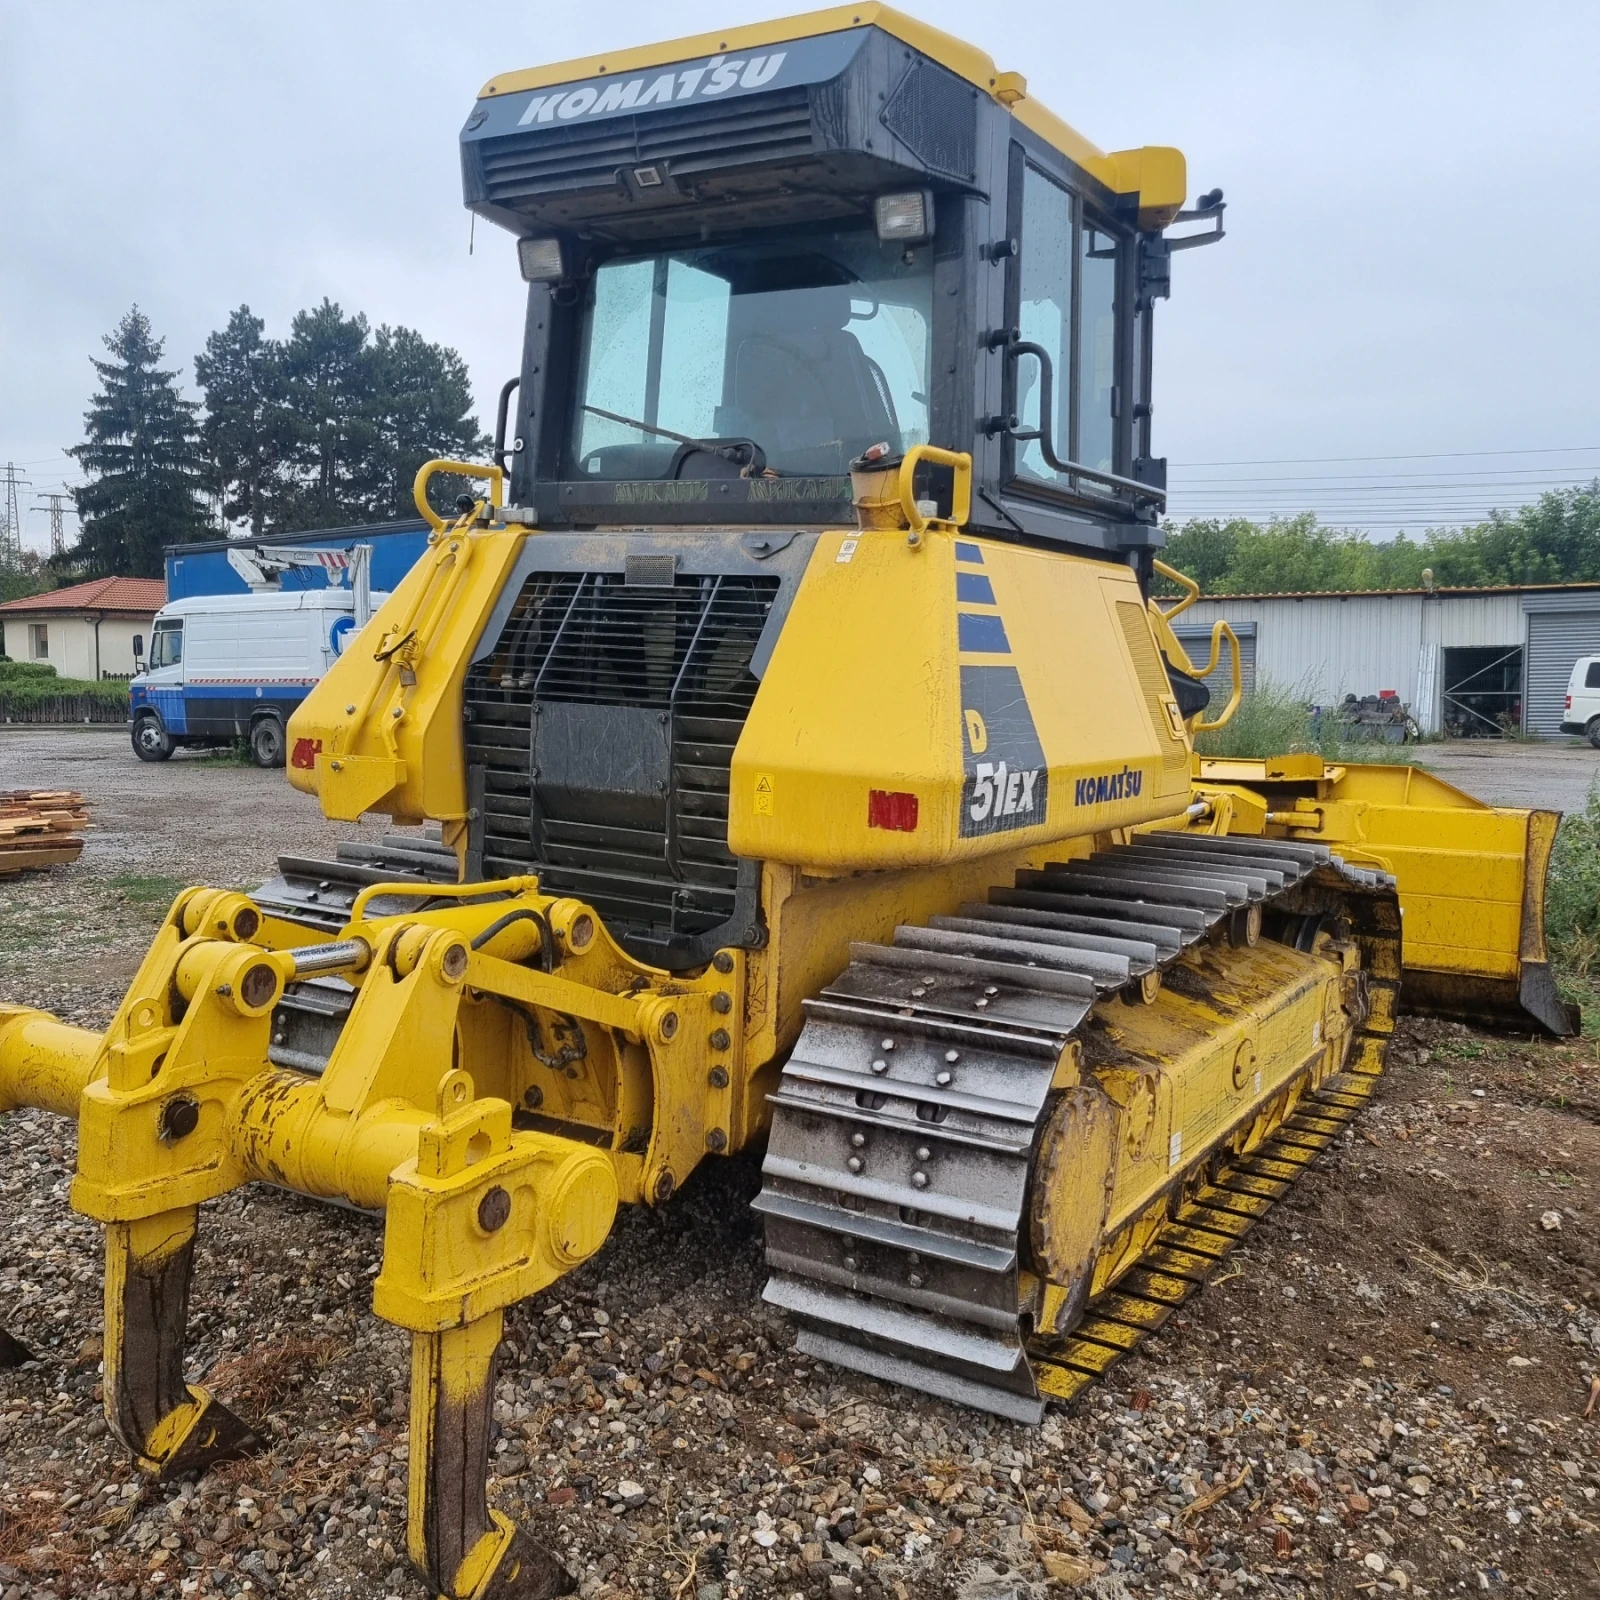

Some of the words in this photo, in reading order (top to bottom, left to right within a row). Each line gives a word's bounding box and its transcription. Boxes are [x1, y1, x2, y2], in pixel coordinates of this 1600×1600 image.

[517, 52, 787, 126] KOMATSU
[964, 709, 988, 754] D
[970, 761, 1039, 821] 51EX
[1074, 765, 1142, 807] KOMATSU
